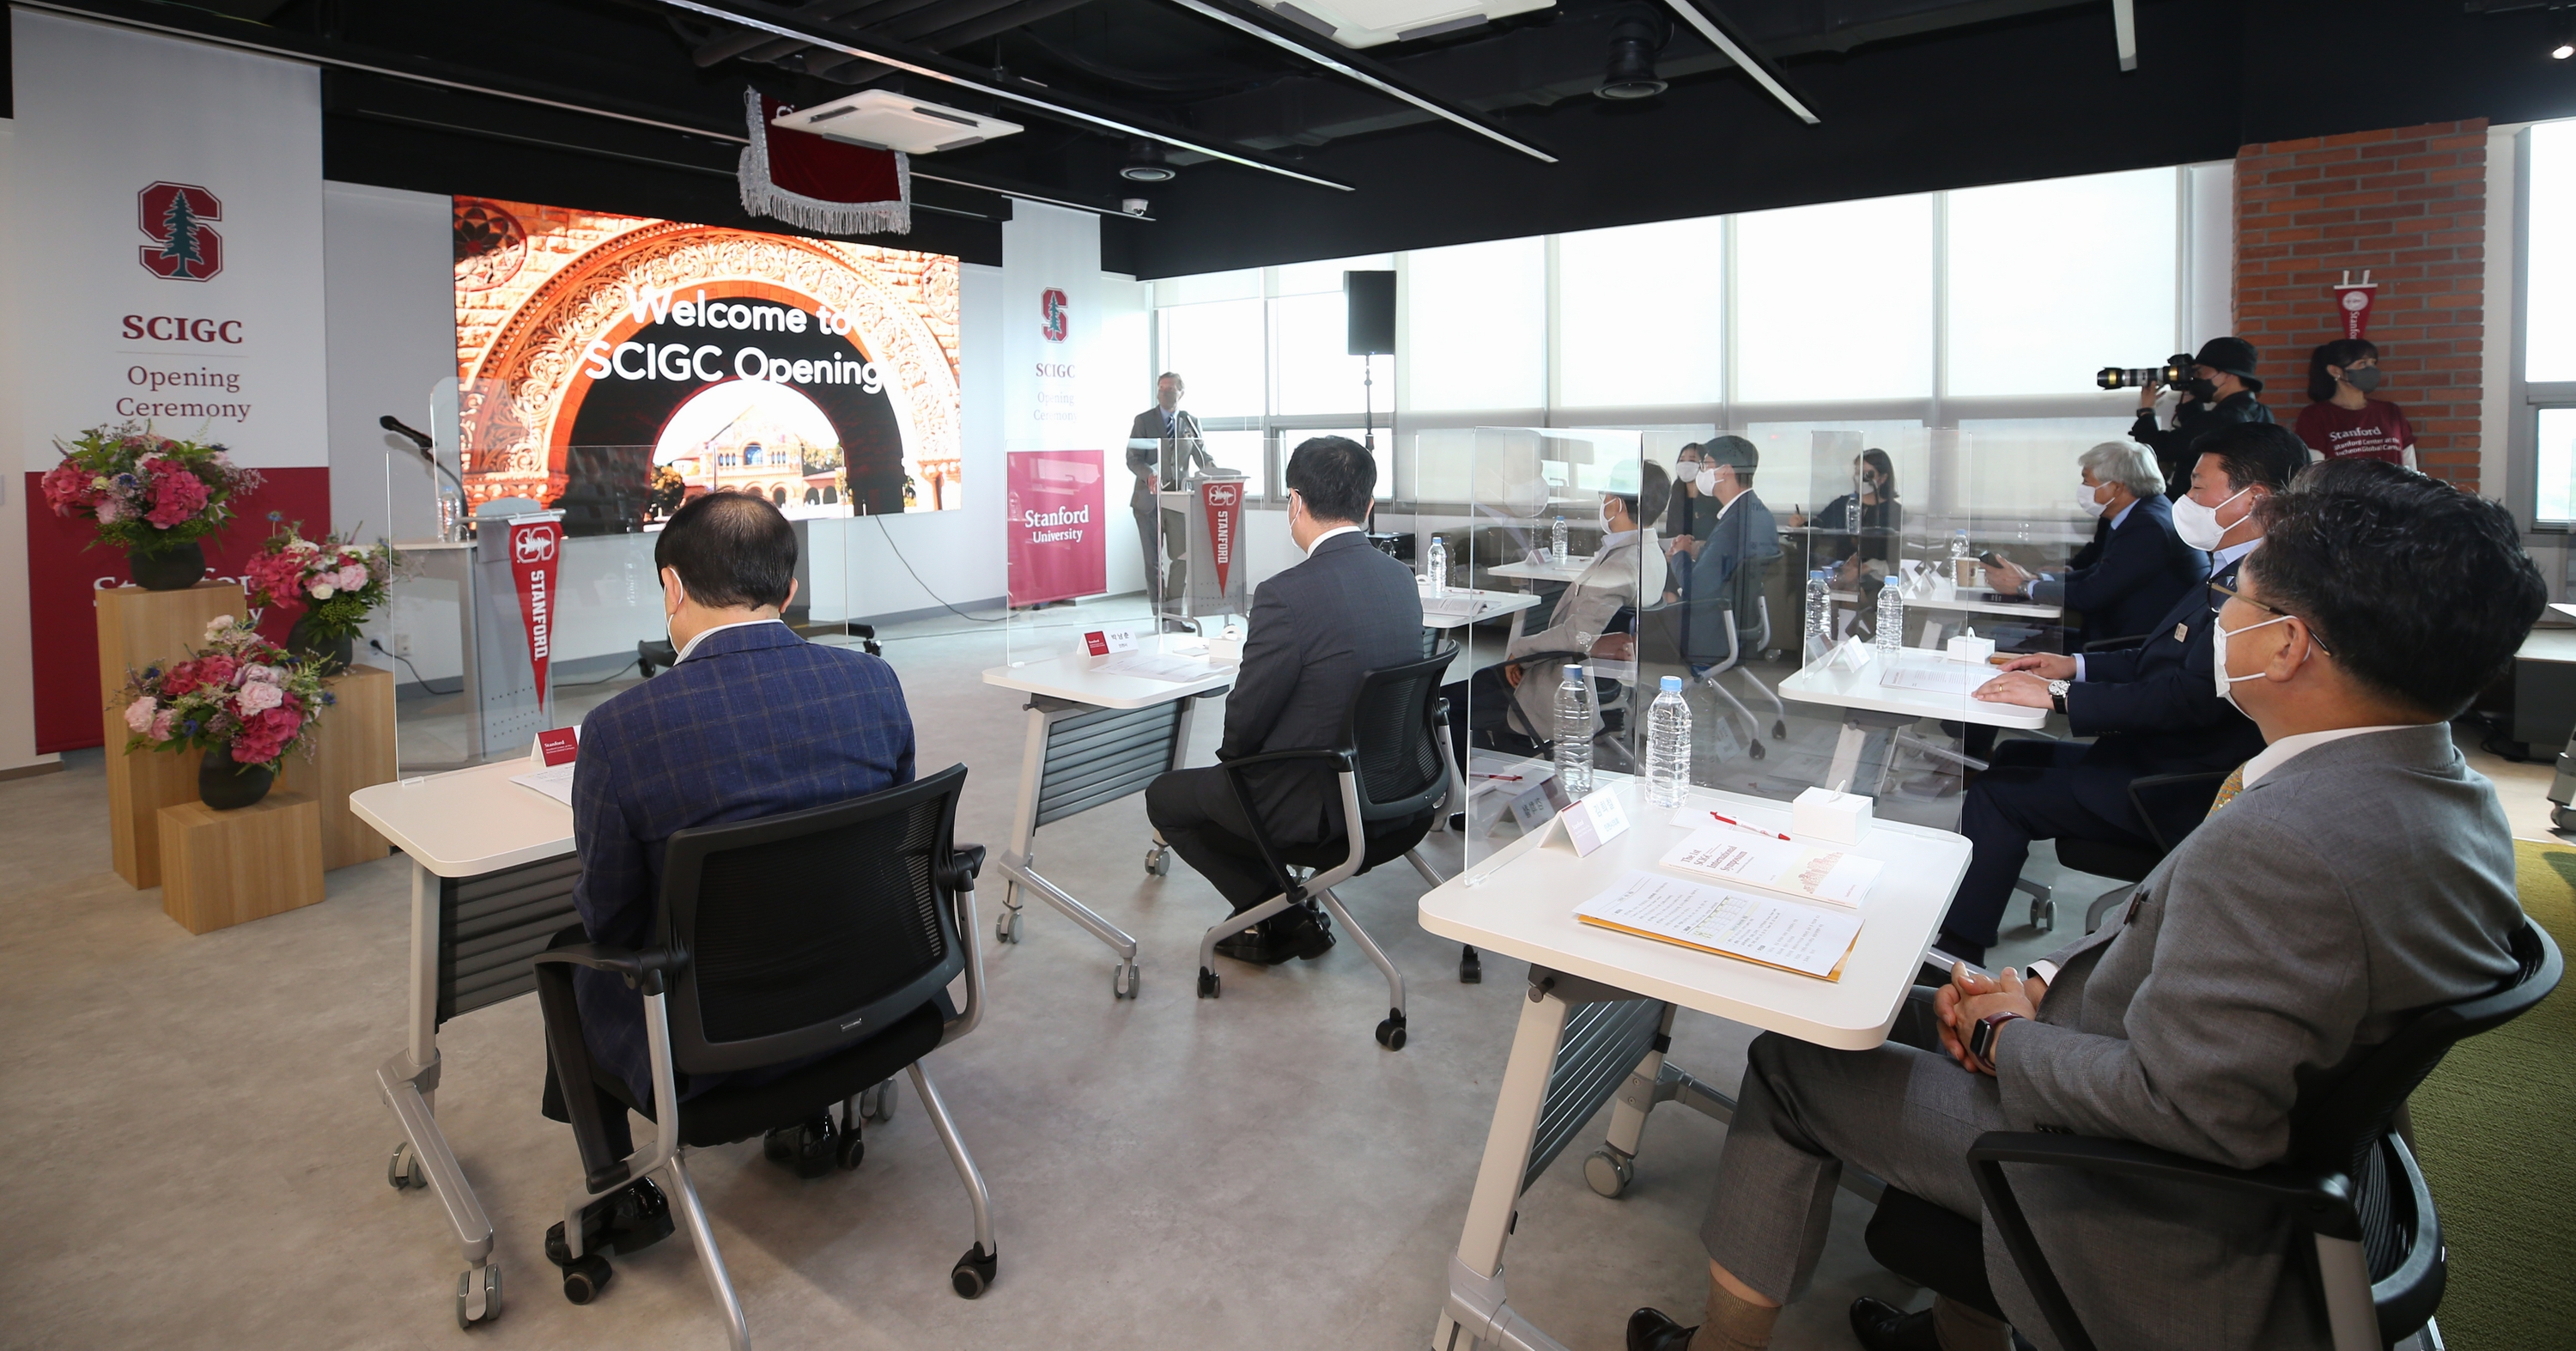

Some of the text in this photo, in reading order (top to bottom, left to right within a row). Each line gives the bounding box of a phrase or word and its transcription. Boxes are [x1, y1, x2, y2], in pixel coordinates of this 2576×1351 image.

[626, 285, 854, 336] Welcome to
[122, 314, 243, 344] SCIGC
[2349, 311, 2360, 340] Stanfo
[127, 365, 240, 393] Opening
[585, 340, 884, 395] SCIGC Opening
[1036, 362, 1075, 378] SCIGC
[116, 397, 252, 423] Ceremony
[1037, 391, 1074, 407] Opening
[1033, 409, 1078, 424] Ceremony
[2329, 426, 2382, 441] Stanford
[1024, 504, 1090, 528] Stanford
[1032, 527, 1083, 543] University
[1218, 510, 1229, 563] STANFORD
[531, 569, 549, 660] STANFORD
[544, 739, 565, 748] Stanford
